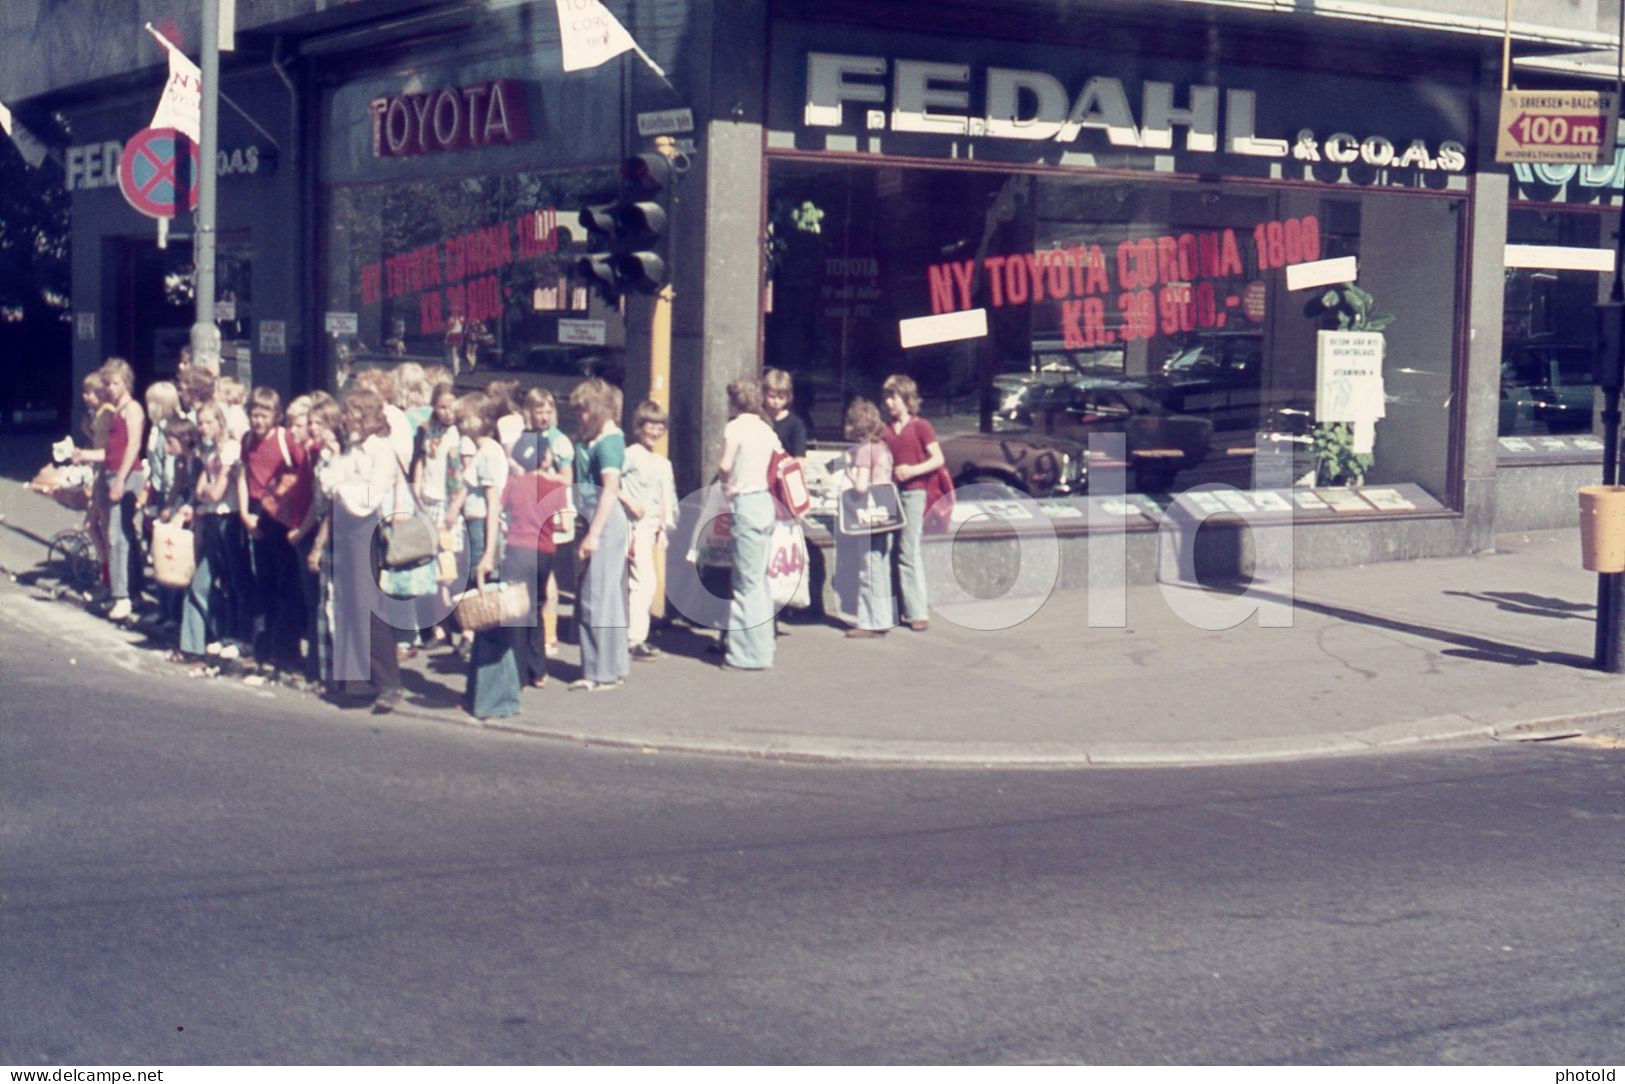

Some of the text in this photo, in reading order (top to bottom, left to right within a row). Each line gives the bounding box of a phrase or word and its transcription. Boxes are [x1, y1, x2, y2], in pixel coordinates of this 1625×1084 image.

[368, 82, 510, 157] TOYOTA
[1520, 116, 1569, 144] 100
[928, 215, 1321, 314] NY TOYOTA CORONA 1800
[1062, 297, 1115, 349] KR.
